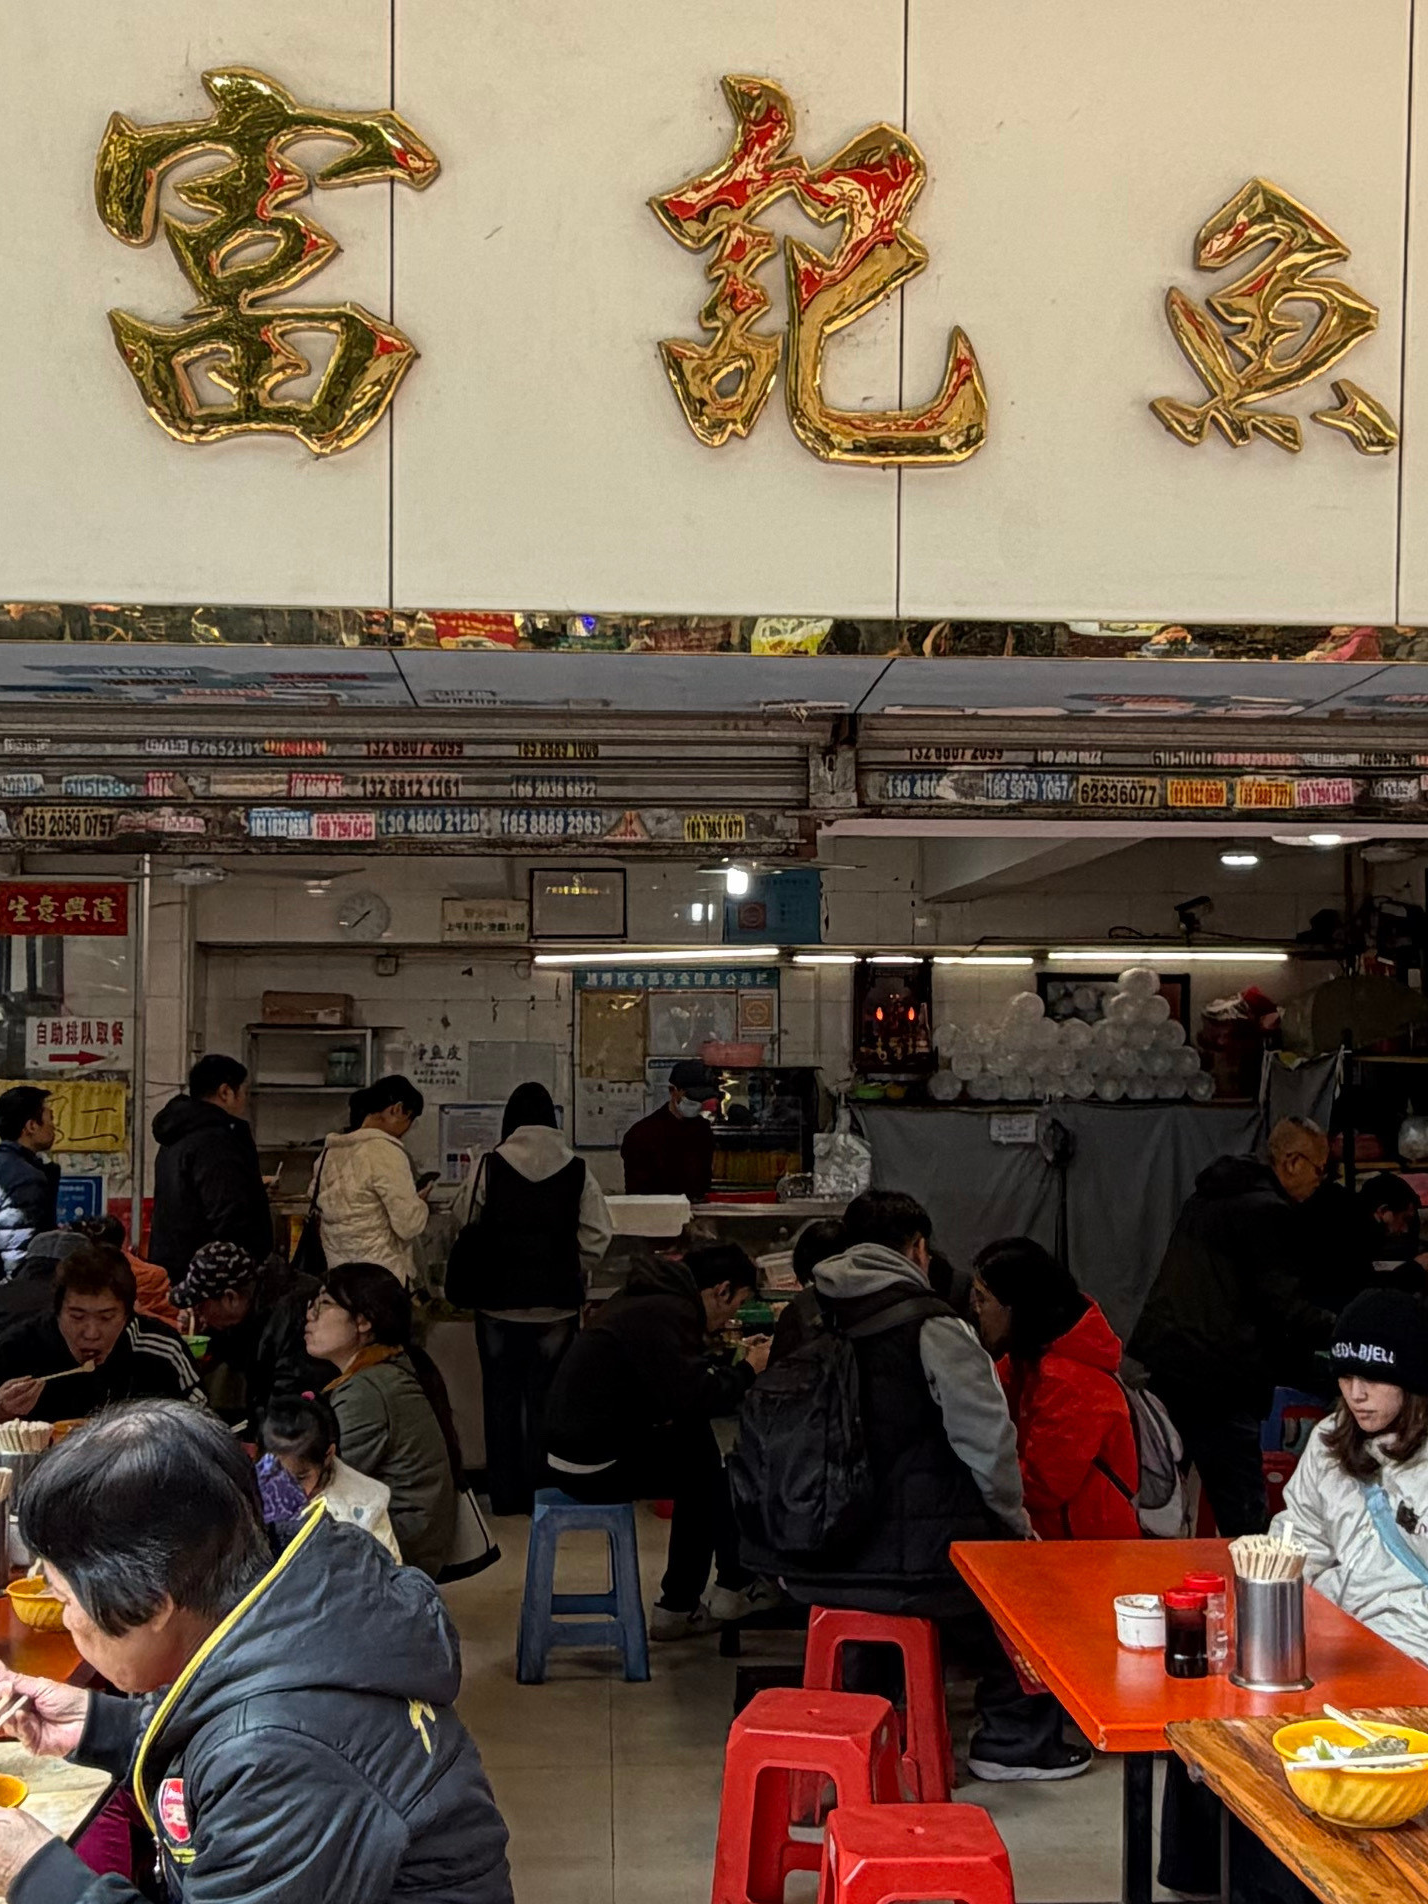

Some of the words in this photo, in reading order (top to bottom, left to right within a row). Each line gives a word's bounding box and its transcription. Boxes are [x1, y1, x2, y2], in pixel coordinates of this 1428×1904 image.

[1080, 783, 1158, 805] 62336077
[407, 809, 442, 833] 4800
[8, 894, 118, 923] 生意興隆
[36, 1020, 124, 1047] 自助排队取餐
